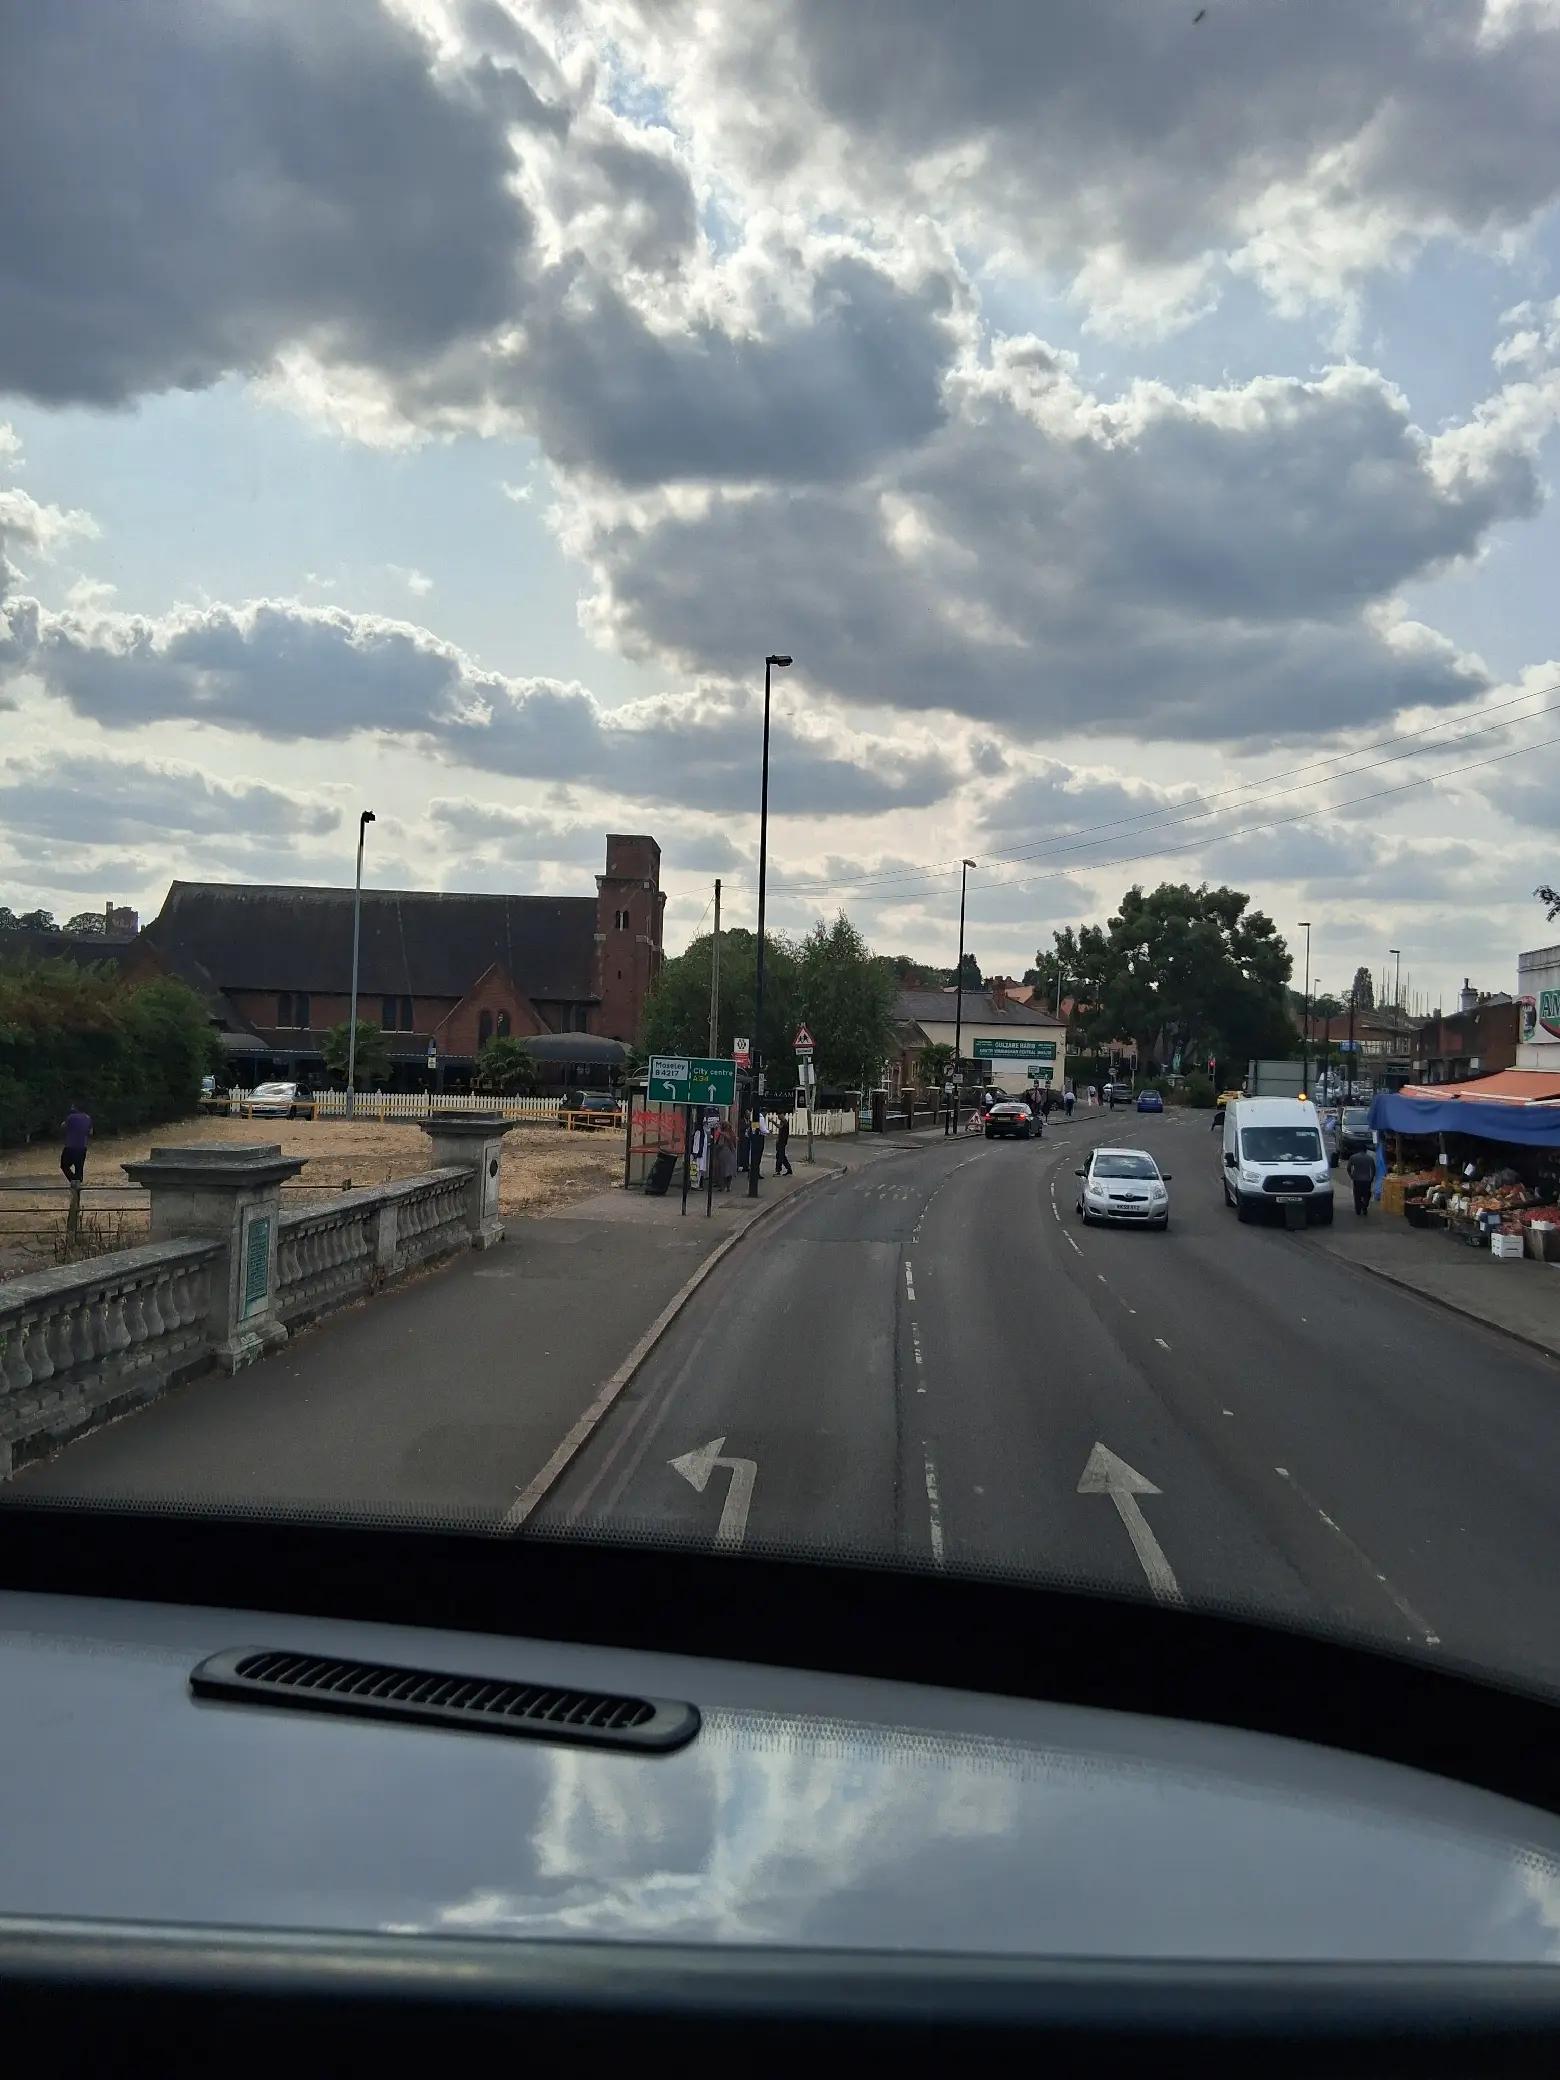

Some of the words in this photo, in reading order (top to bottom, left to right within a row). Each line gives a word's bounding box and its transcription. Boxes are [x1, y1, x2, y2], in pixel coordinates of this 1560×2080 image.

[655, 1061, 685, 1070] Moseley
[693, 1067, 708, 1075] City
[709, 1068, 733, 1077] centre
